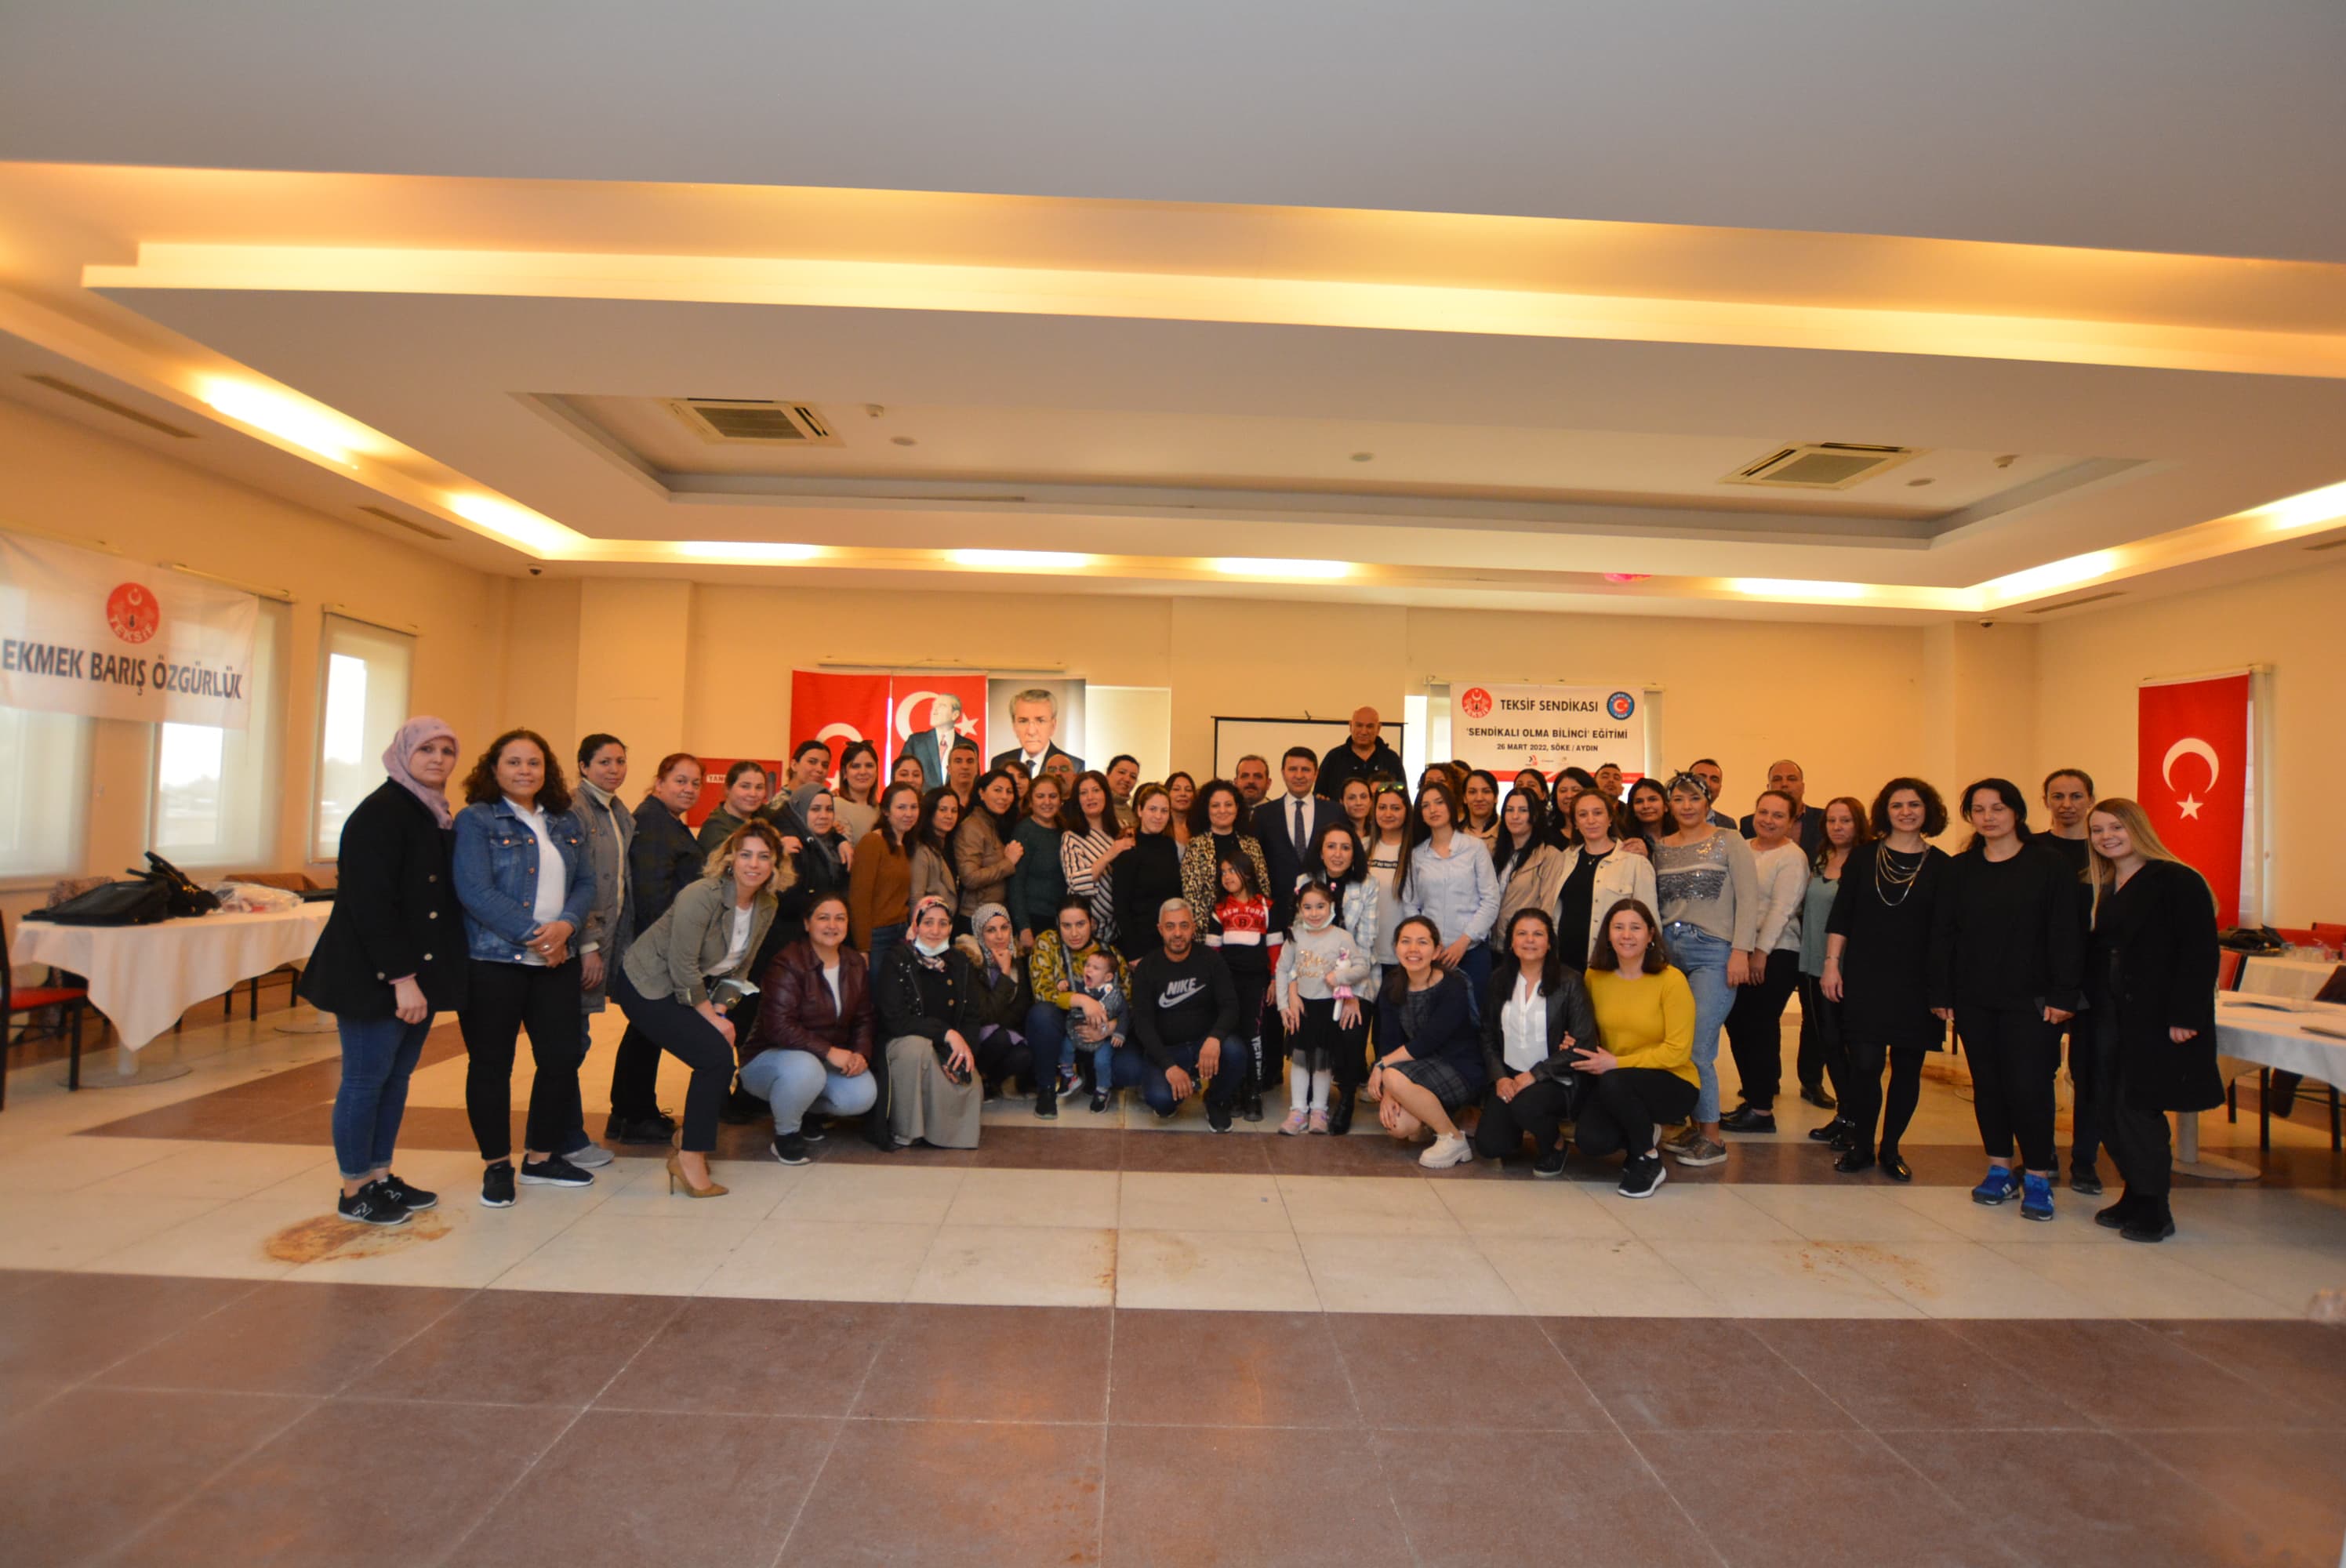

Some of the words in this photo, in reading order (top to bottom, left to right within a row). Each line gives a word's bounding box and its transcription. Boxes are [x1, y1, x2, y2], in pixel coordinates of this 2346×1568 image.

[2, 639, 84, 679] EKMEK
[90, 652, 147, 695] BARIŞ
[153, 655, 242, 699] ÖZGÜRLÜK
[1500, 697, 1535, 711] TEKSİF
[1539, 698, 1599, 712] SENDİKASI
[1522, 728, 1549, 738] OLMA
[1592, 728, 1628, 739] EĞİTİMİ
[1166, 977, 1197, 996] NIKE
